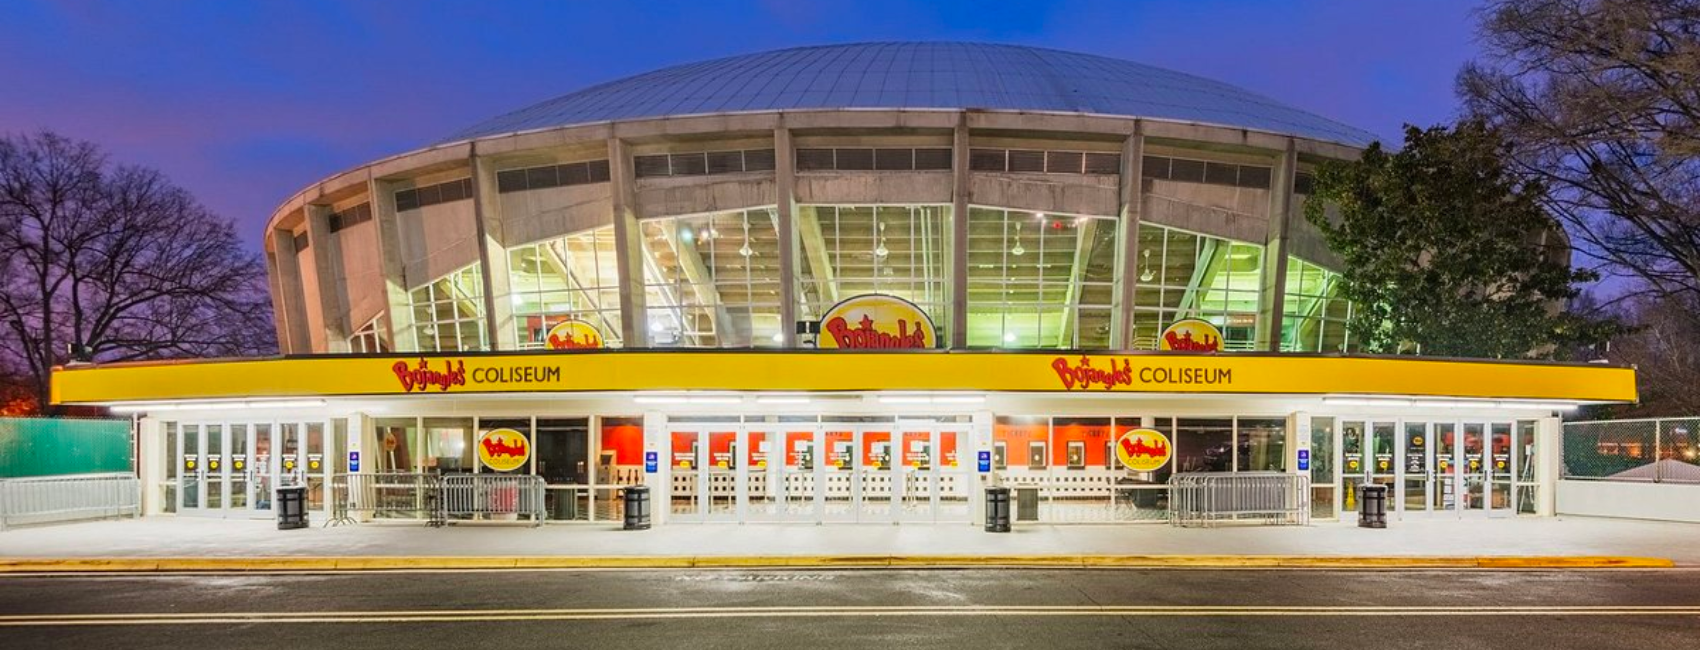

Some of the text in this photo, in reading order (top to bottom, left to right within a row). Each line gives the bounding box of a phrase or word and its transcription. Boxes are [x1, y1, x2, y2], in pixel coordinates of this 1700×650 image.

[472, 366, 561, 383] COLISEUM
[1052, 355, 1232, 391] Bojangles' COLISEUM
